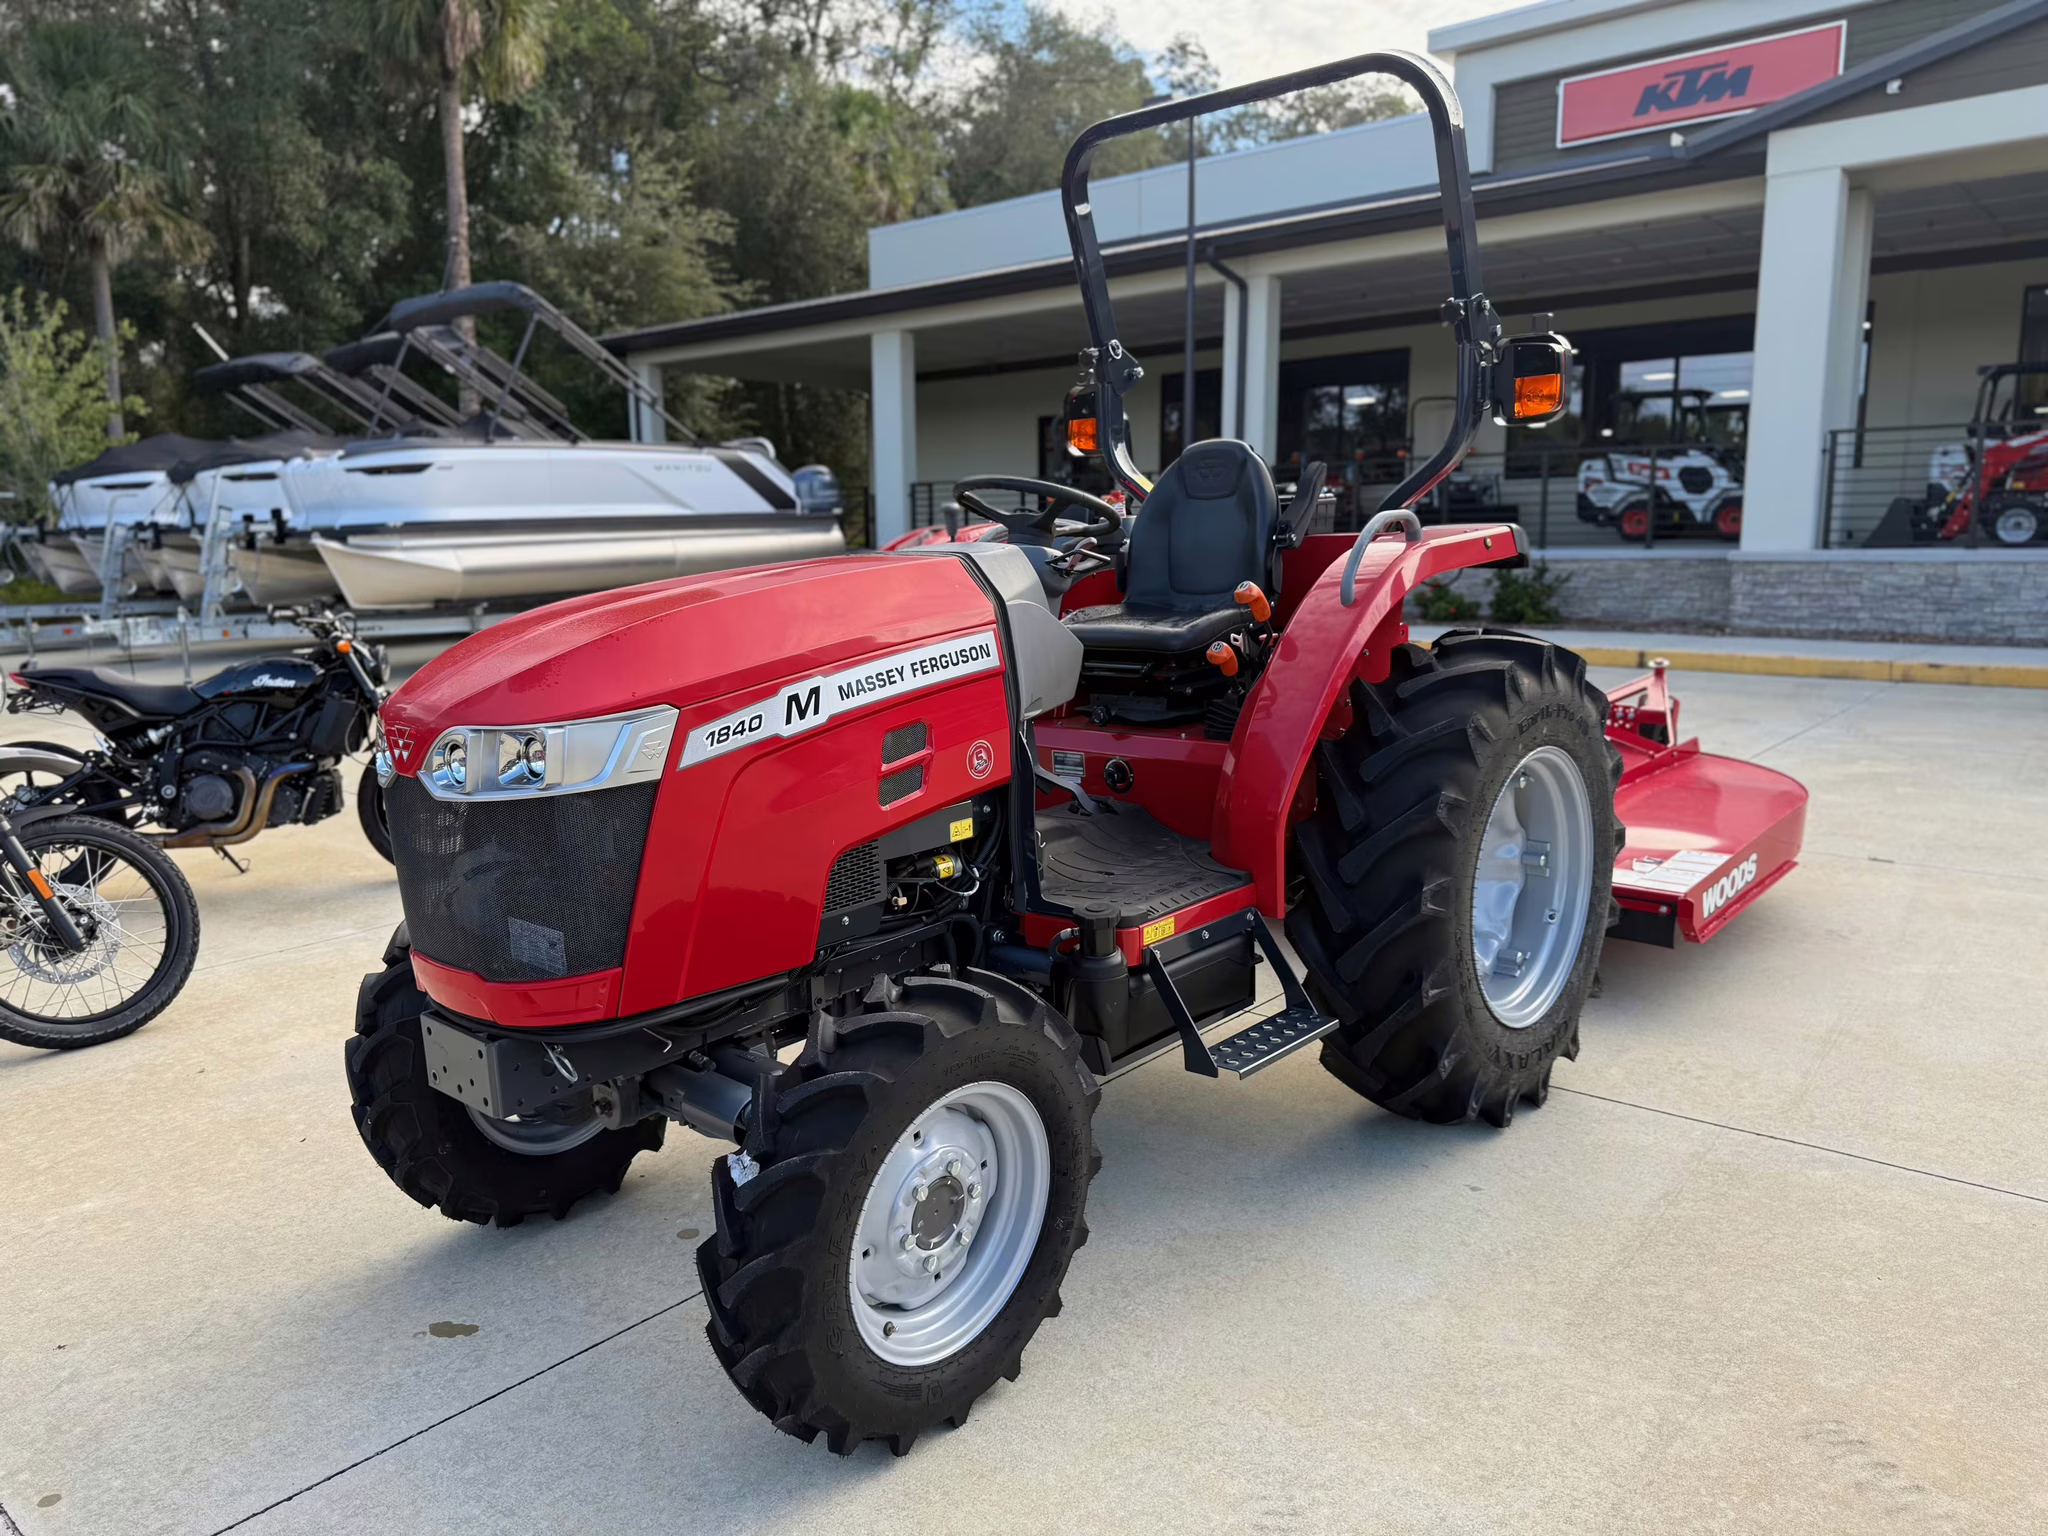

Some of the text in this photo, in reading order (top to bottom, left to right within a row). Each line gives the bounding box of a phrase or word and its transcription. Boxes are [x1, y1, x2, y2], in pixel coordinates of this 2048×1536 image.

[1634, 61, 1753, 117] KTM
[252, 673, 296, 688] Indian
[838, 643, 992, 701] MASSEY FERGUSON
[785, 685, 821, 726] M
[705, 713, 763, 748] 1840
[1702, 852, 1758, 919] WOODS
